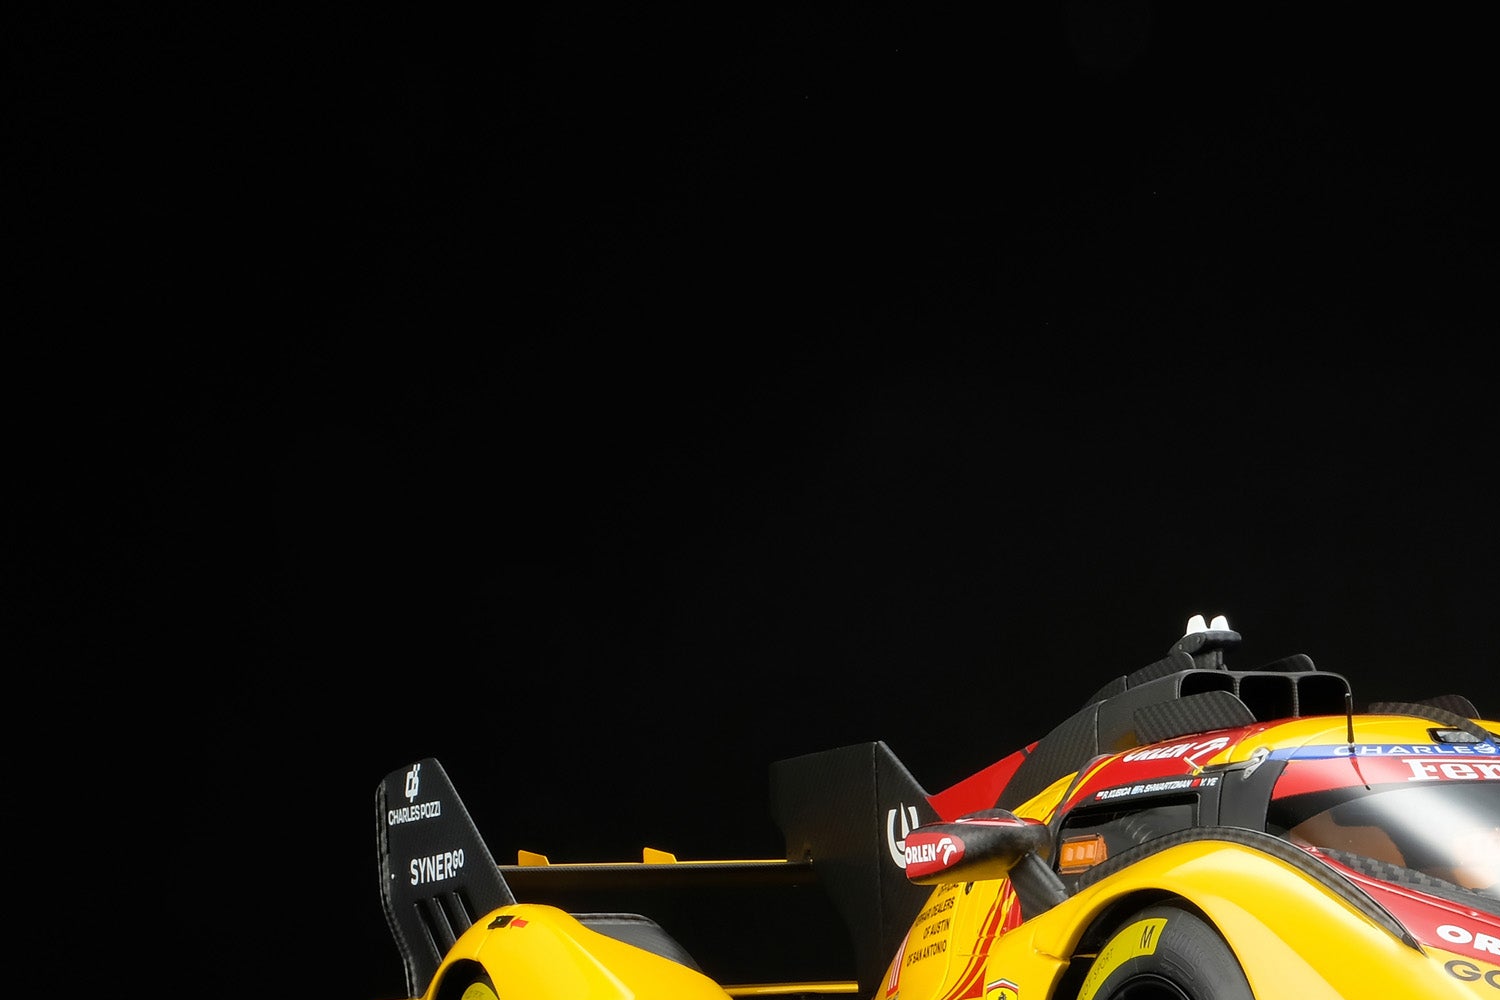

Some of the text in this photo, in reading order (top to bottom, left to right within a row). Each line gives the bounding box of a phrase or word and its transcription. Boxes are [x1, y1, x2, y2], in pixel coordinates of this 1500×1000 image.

[388, 801, 440, 825] CHARLES POZZI
[905, 844, 936, 864] ORLEN
[1140, 925, 1156, 949] M
